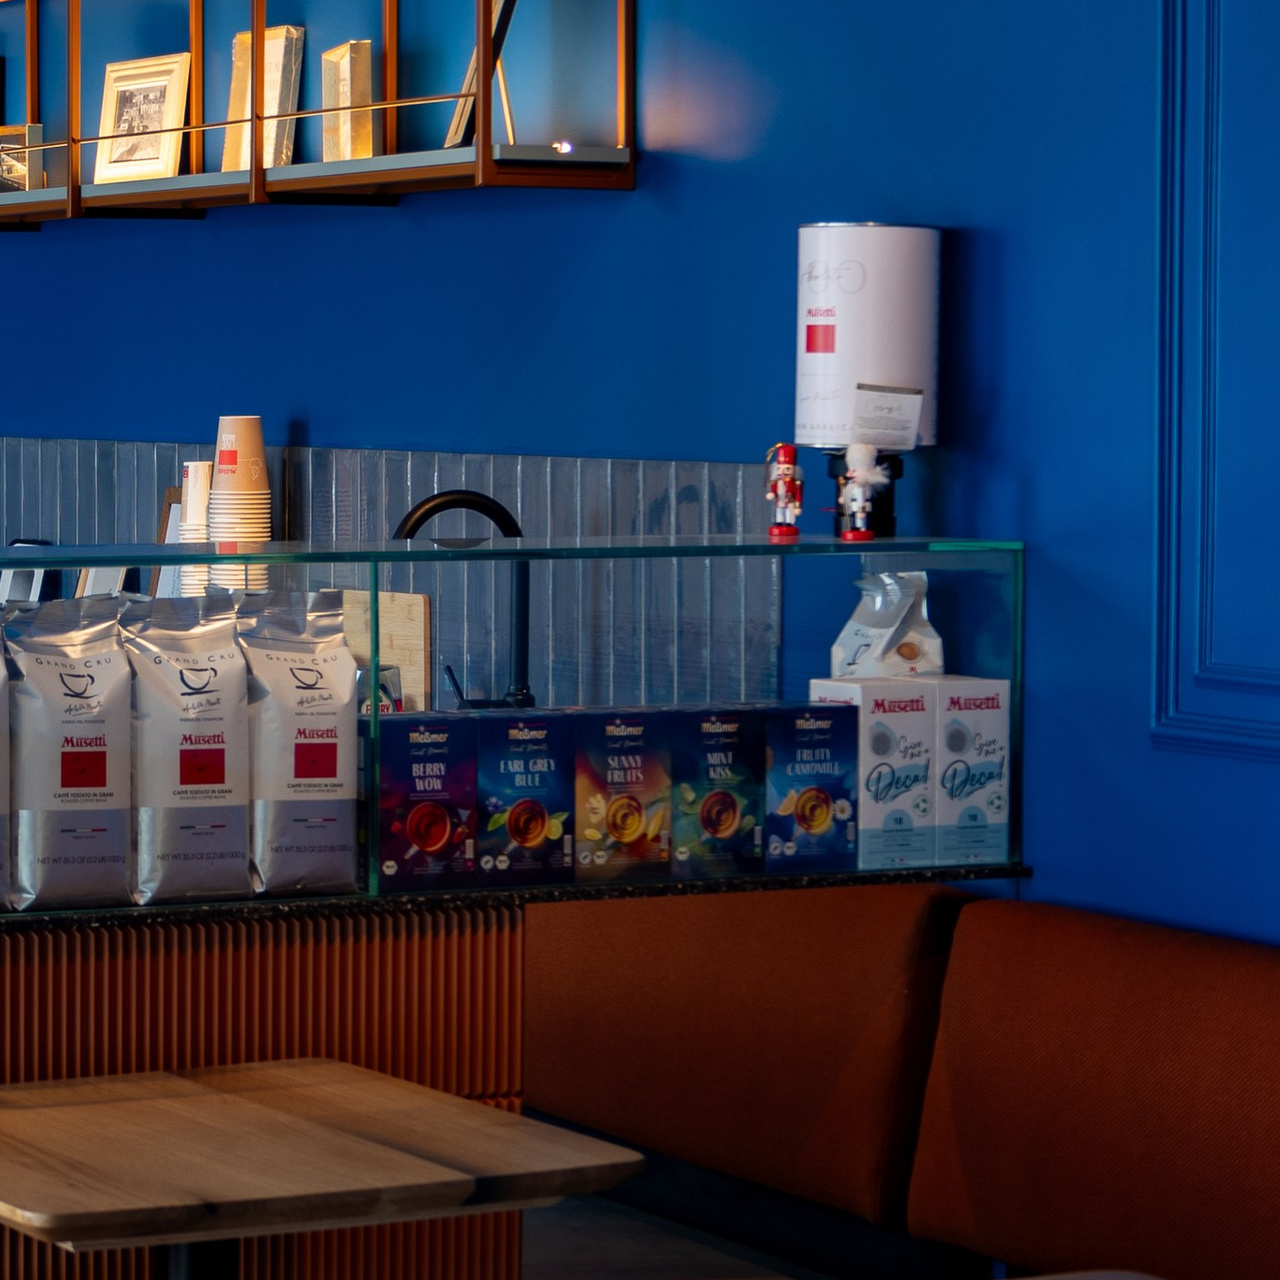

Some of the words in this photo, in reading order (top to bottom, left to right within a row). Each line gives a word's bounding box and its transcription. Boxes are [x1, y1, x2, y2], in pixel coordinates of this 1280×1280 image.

[35, 657, 76, 670] GRAND
[84, 658, 111, 668] CRU
[208, 653, 234, 662] CRU
[266, 654, 305, 664] GRAND
[311, 655, 337, 666] CRU
[871, 695, 926, 713] Musetti
[947, 693, 1002, 711] Musetti
[366, 704, 390, 714] FRY
[180, 731, 225, 745] Musetti
[294, 726, 339, 739] Musetti
[61, 734, 107, 747] Musetti
[898, 735, 923, 759] Give
[973, 733, 999, 757] Give
[707, 752, 733, 765] MINT
[796, 748, 832, 761] FRUITY
[500, 760, 525, 773] EARL
[529, 759, 556, 772] GREY
[607, 755, 642, 768] SUNNY
[412, 763, 446, 776] BERRY
[607, 769, 644, 782] FRUITS
[709, 766, 732, 779] KISS
[415, 777, 443, 790] WOW
[515, 774, 540, 787] BLUE
[37, 854, 51, 864] NET
[52, 854, 62, 864] WT
[157, 851, 170, 860] NET
[171, 851, 182, 860] WT
